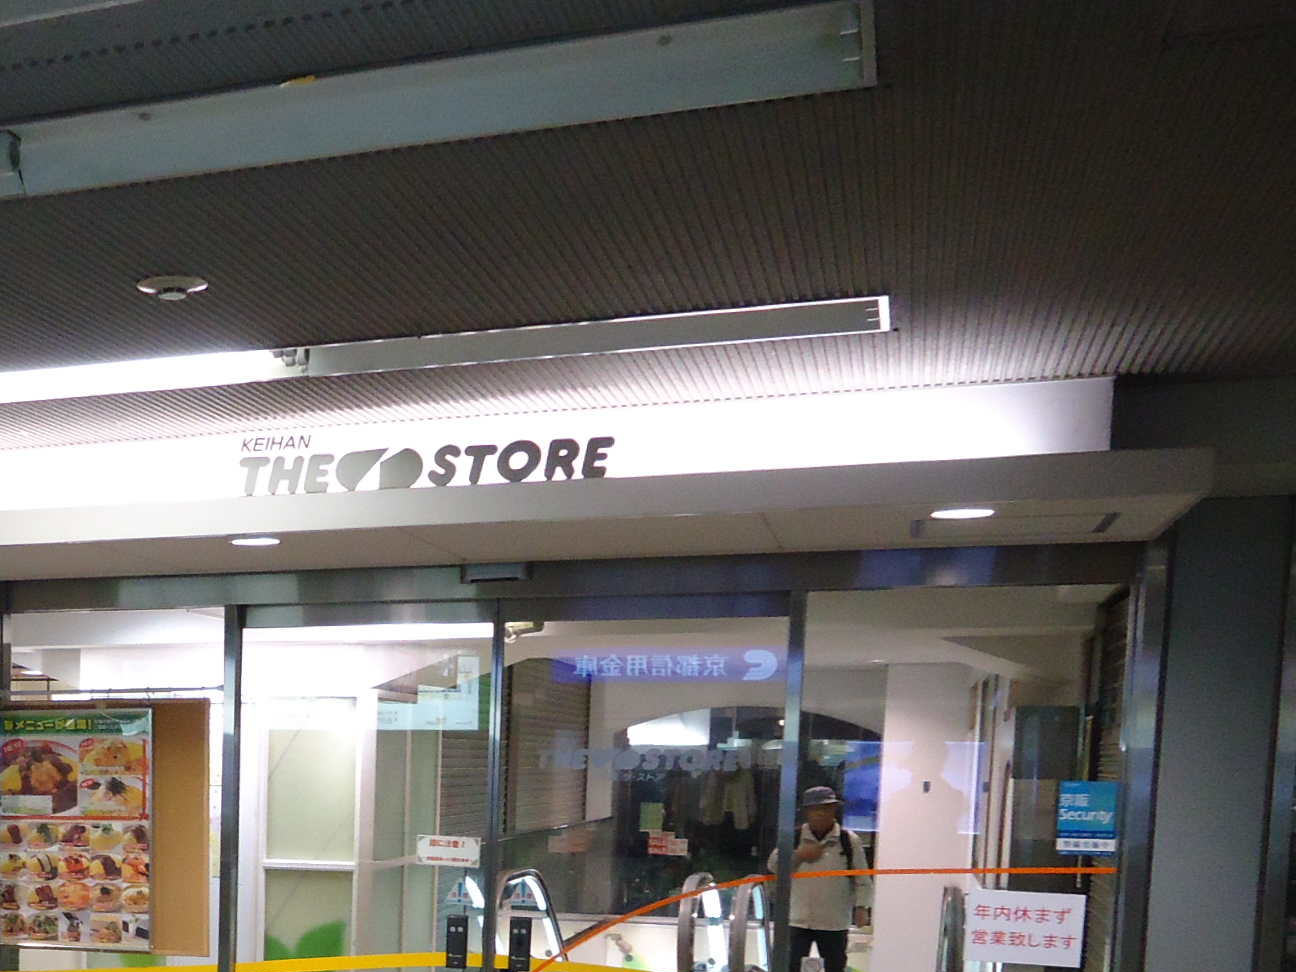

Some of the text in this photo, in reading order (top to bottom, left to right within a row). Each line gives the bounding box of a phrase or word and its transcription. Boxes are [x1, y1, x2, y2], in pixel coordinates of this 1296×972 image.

[240, 434, 311, 453] KEIHAN
[239, 436, 616, 497] THE STORE
[1058, 808, 1115, 824] Security
[973, 903, 1073, 925] 年内休まず
[971, 928, 1078, 950] 営業致します
